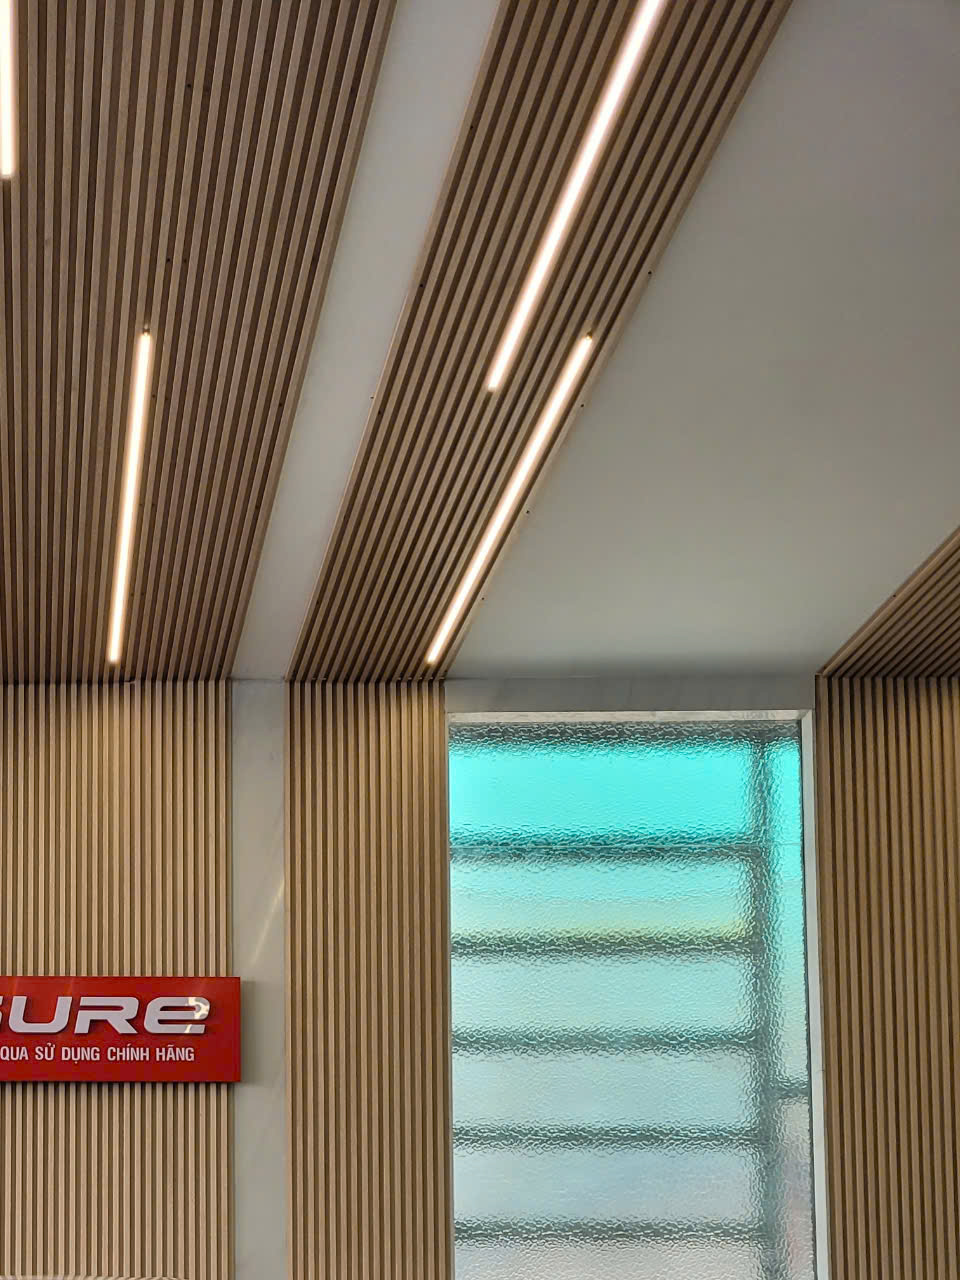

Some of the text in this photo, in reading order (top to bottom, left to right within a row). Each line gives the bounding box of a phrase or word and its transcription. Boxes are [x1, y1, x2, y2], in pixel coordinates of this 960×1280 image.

[0, 1046, 29, 1061] QUA
[35, 1042, 55, 1060] SỬ
[61, 1046, 101, 1063] DỤNG
[107, 1043, 150, 1060] CHÍNH
[155, 1043, 195, 1061] HÃNG
